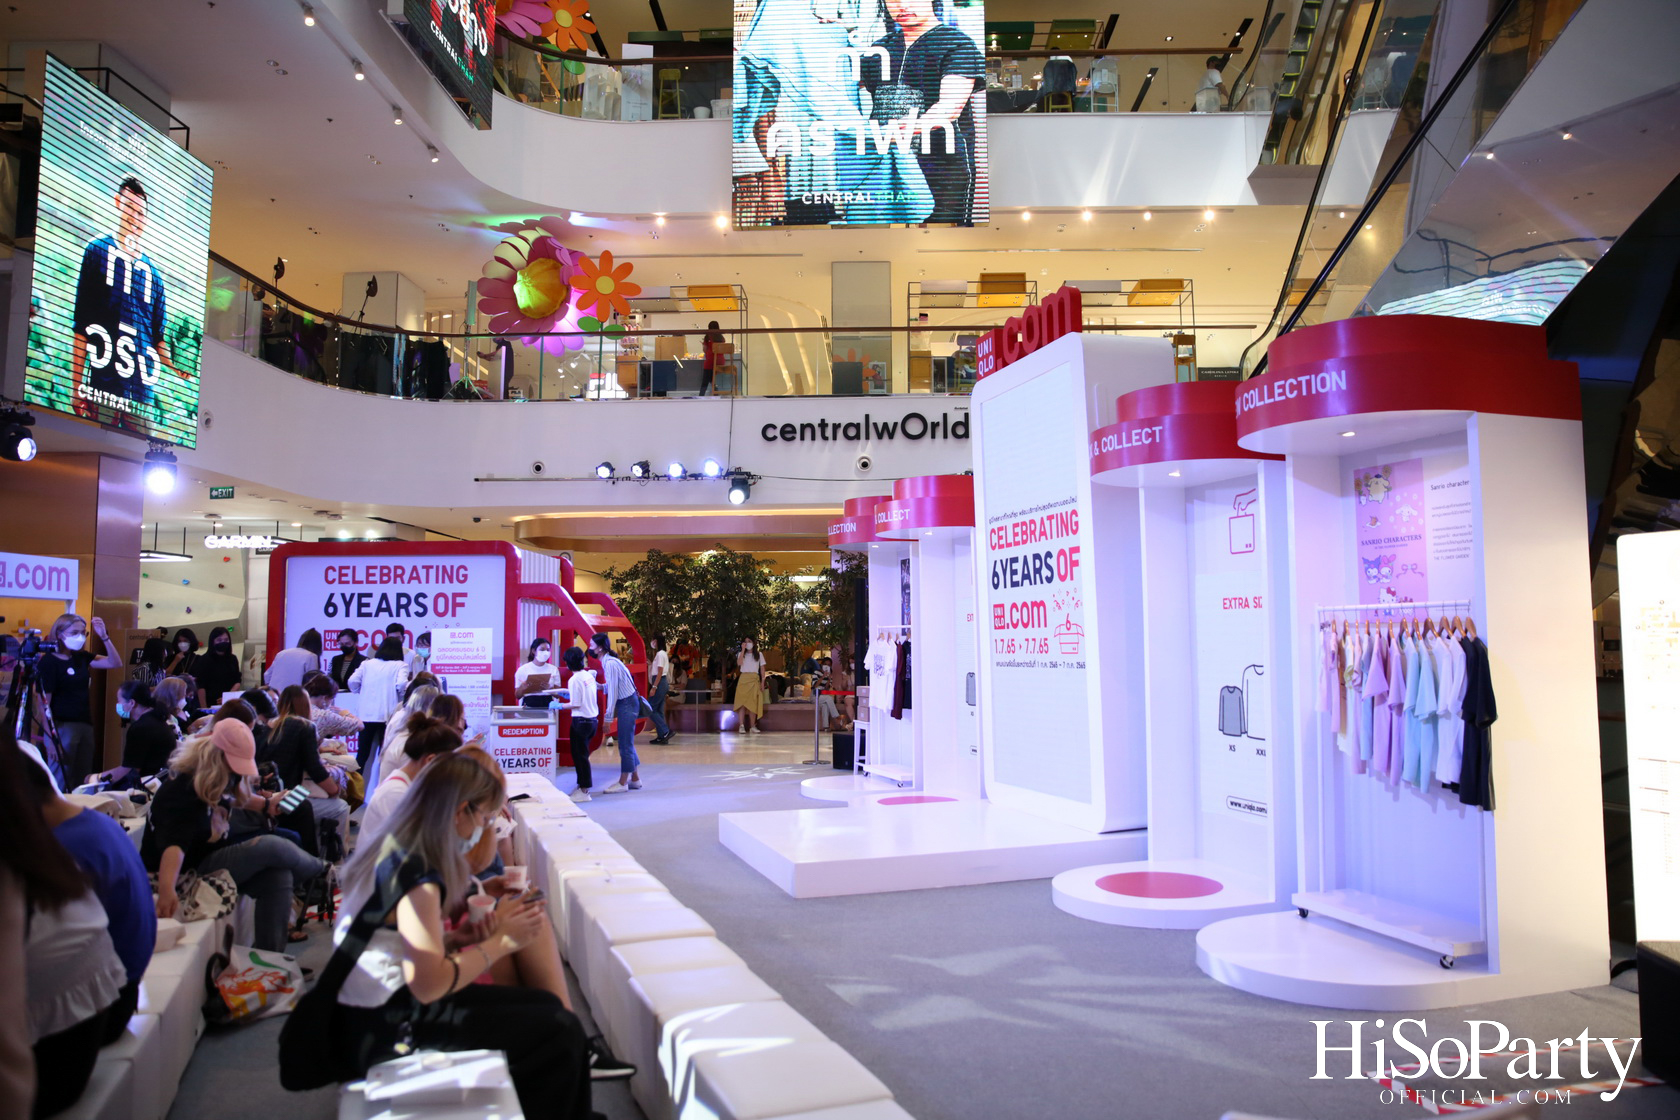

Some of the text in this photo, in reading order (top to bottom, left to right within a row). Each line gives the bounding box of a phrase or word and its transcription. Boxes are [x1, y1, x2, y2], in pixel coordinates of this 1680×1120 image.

[977, 337, 993, 359] UNI
[978, 354, 995, 377] QLO
[1242, 369, 1347, 412] COLLECTION
[761, 413, 970, 442] centralwOrld
[1101, 426, 1163, 453] COLLECT
[218, 488, 233, 498] EXIT
[877, 508, 911, 524] COLLECT
[989, 508, 1080, 551] CELEBRATING
[204, 535, 272, 549] GARMIN
[1360, 538, 1383, 547] SANRIO
[1383, 534, 1423, 544] CHARACTERS
[325, 565, 469, 585] CELEBRATING
[1056, 546, 1081, 583] OF
[7, 562, 70, 593] .com
[432, 592, 468, 618] OF
[1222, 596, 1250, 610] EXTRA
[1006, 600, 1047, 630] .com
[994, 637, 1049, 654] 1.7.65 7.7.65
[494, 747, 552, 756] CELEBRATING
[1228, 744, 1236, 752] XS
[538, 757, 552, 768] OF
